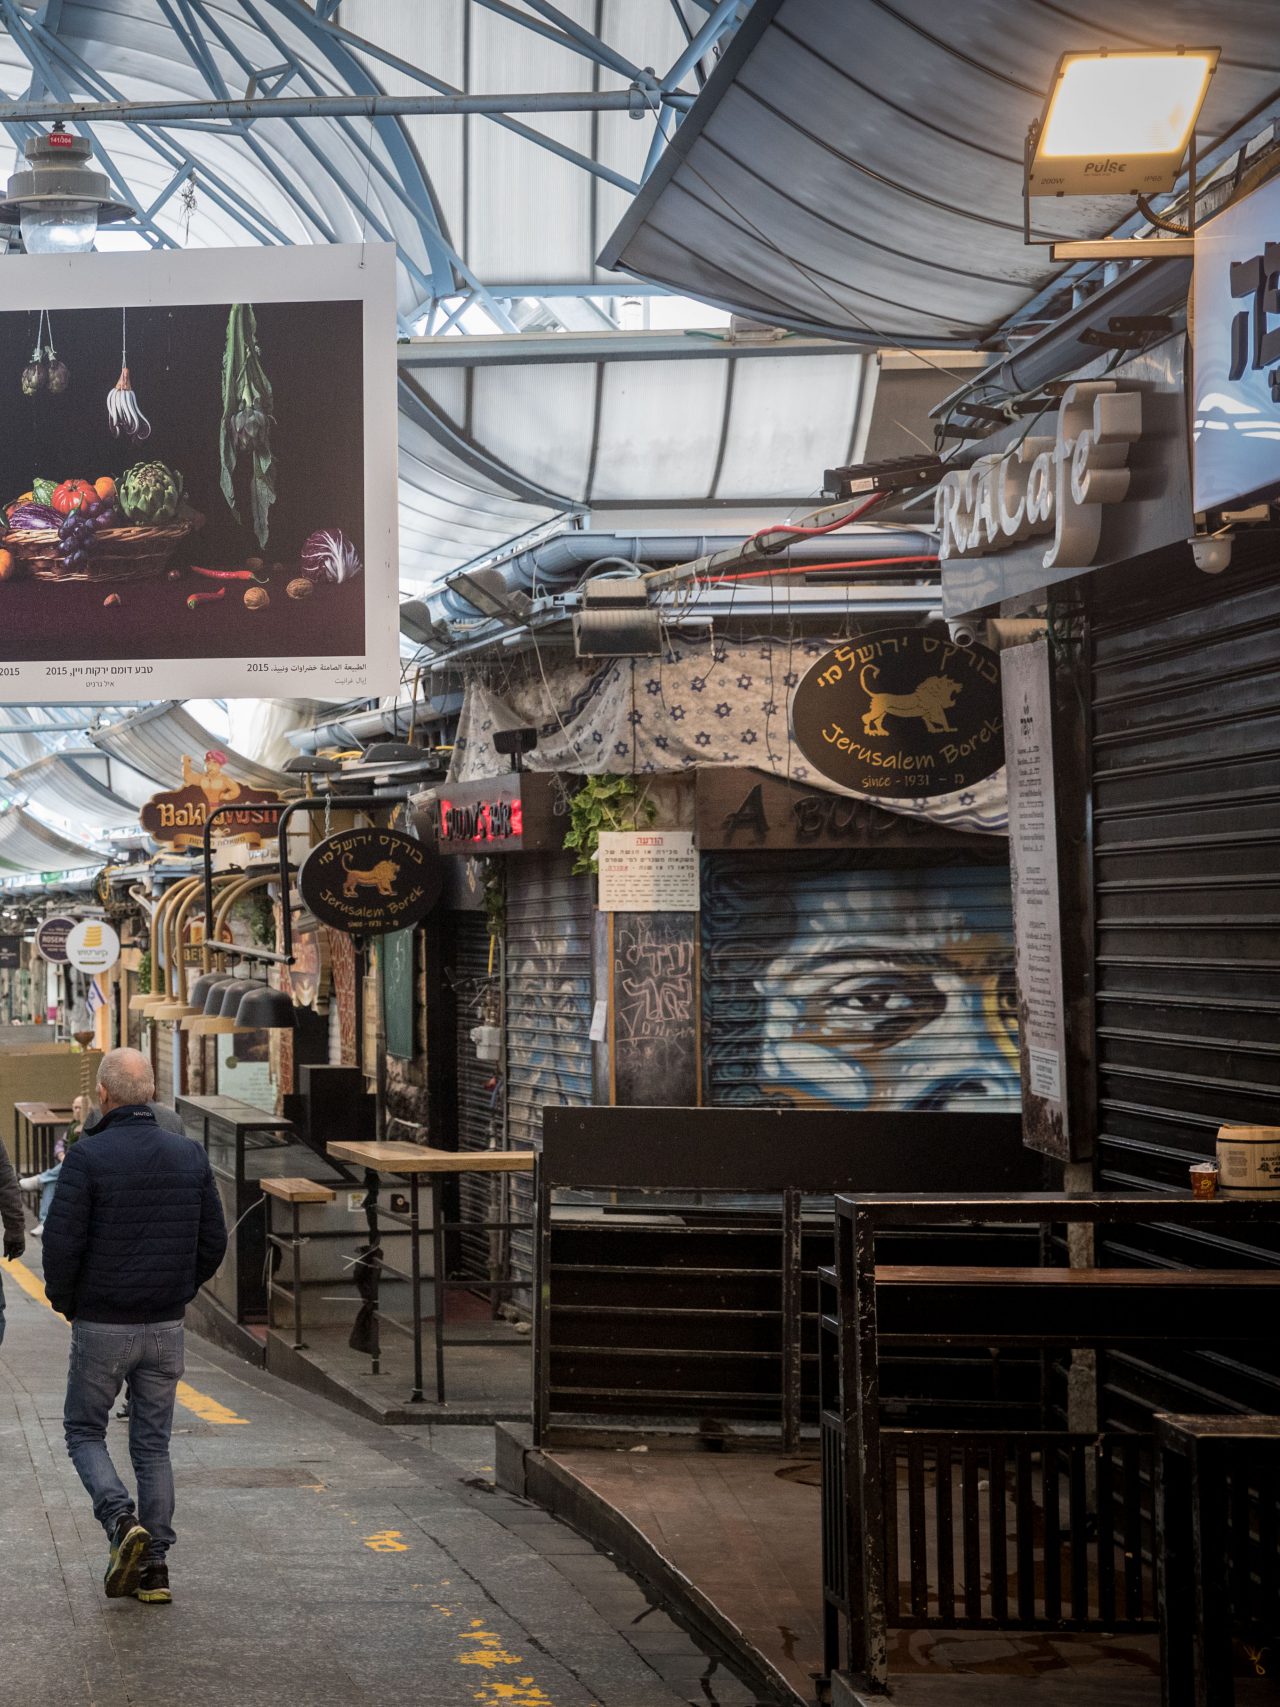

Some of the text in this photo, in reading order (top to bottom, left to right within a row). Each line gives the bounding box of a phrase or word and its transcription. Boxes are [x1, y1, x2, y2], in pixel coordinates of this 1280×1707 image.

[247, 664, 269, 672] 2015
[320, 663, 341, 671] الصامتة
[344, 663, 366, 672] الطبيعة
[817, 637, 1000, 687] בורקס ירושלמי
[46, 666, 153, 677] טבע דומם ירקות ויין, 2015
[822, 717, 1004, 770] Jerusalem Borek
[862, 775, 891, 788] since
[904, 774, 929, 786] 1931
[319, 835, 424, 865] בורקס ירושלמי
[320, 886, 425, 918] Jerusalem Borek
